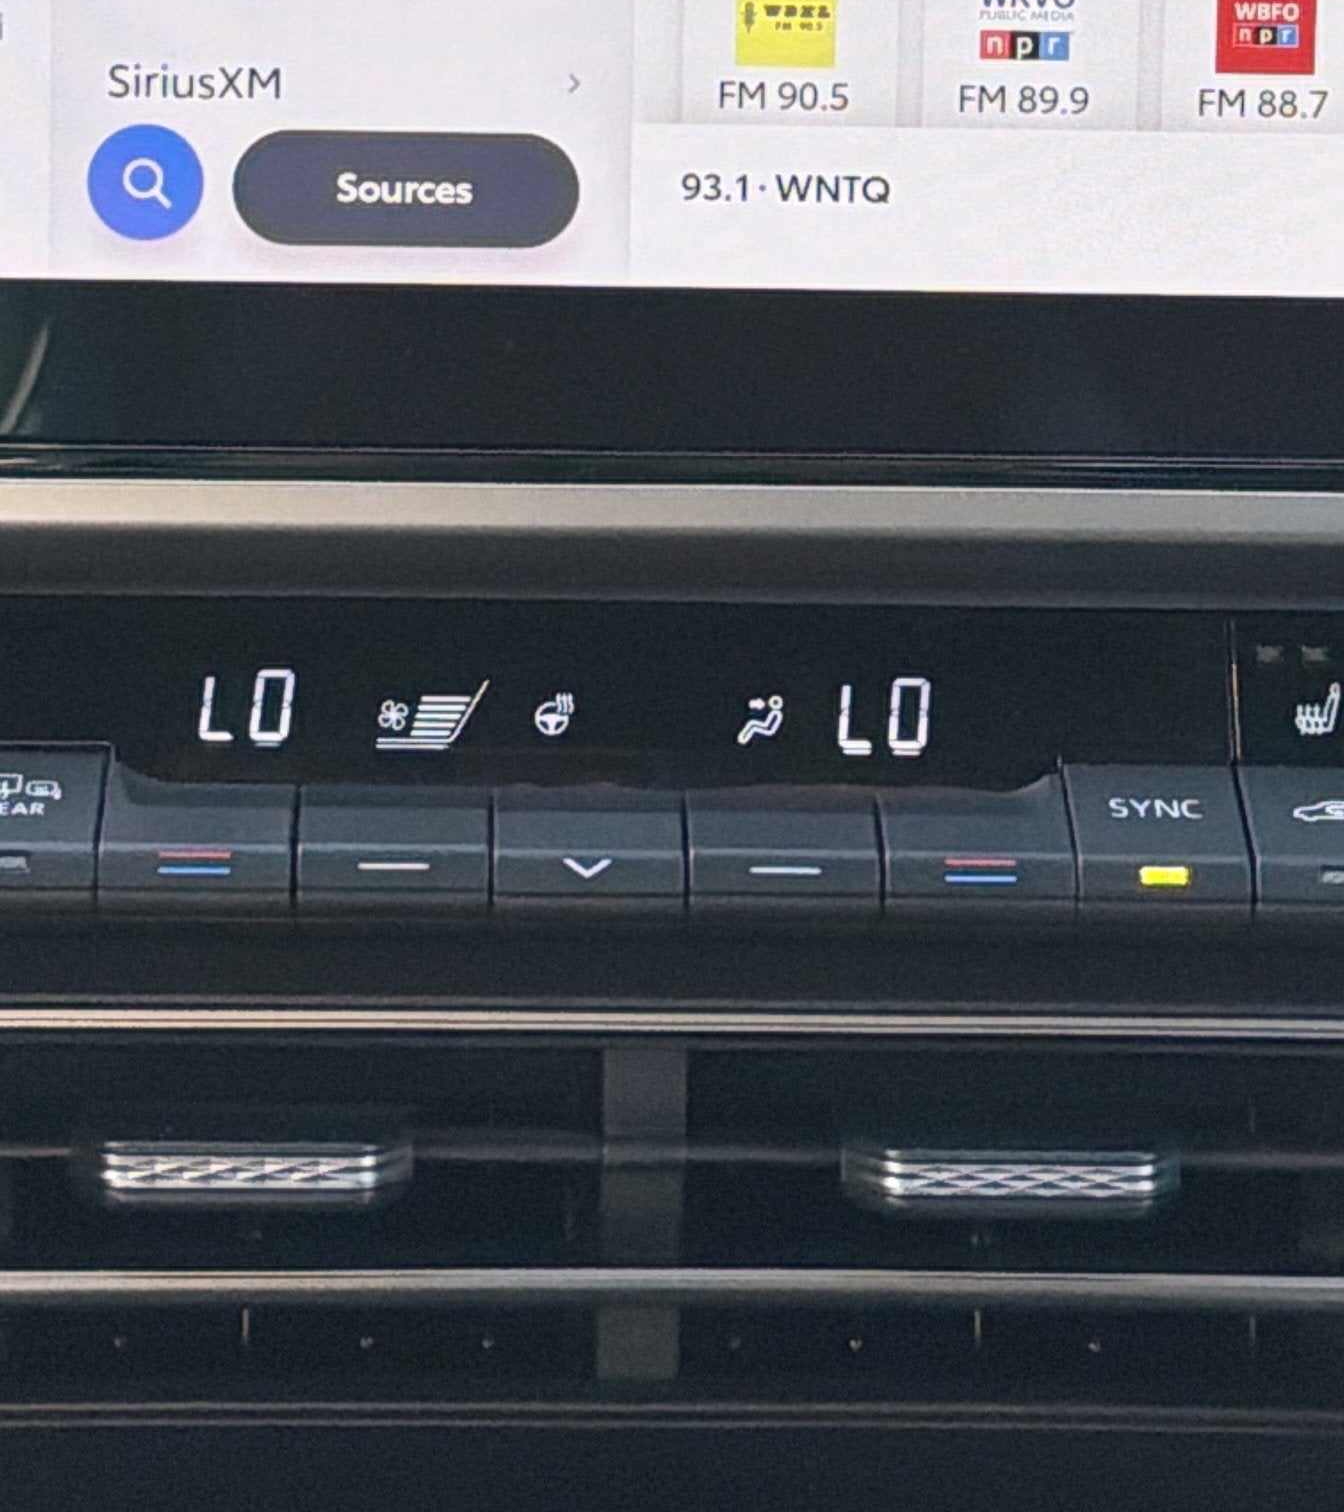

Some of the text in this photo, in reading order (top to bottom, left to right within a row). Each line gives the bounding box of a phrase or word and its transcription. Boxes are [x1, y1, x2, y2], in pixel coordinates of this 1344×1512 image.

[1234, 2, 1300, 22] WBFO
[986, 35, 1061, 61] npr
[108, 63, 281, 100] SiriusXM
[719, 80, 849, 111] FM 90.5
[959, 84, 1090, 115] FM 89.9
[1198, 88, 1329, 119] FM 88.7
[336, 172, 473, 205] Sources
[775, 174, 890, 204] WNTQ
[1108, 797, 1202, 819] SYNC
